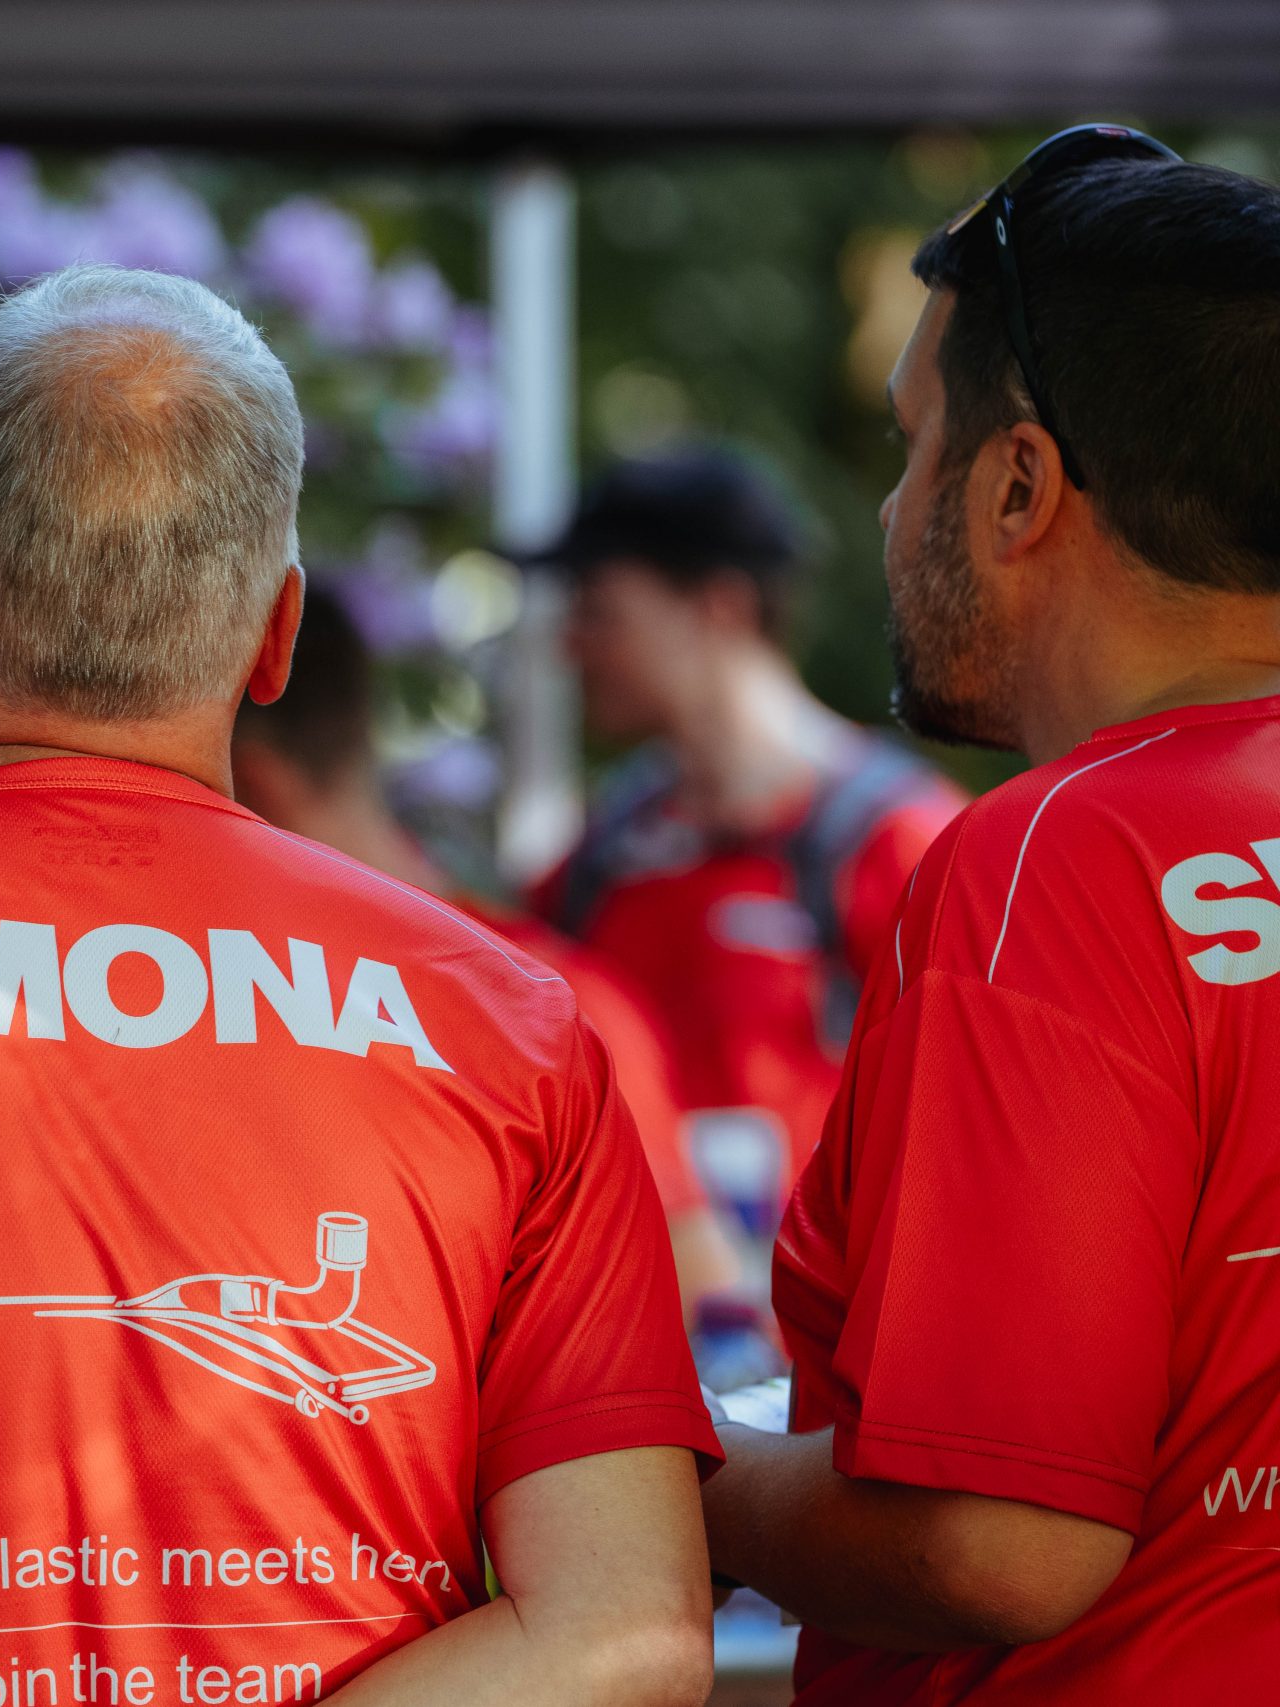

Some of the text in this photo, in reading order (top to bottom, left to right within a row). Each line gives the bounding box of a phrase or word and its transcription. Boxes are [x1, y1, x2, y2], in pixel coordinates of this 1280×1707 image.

[161, 1536, 335, 1587] meets
[69, 1652, 155, 1706] the
[175, 1654, 323, 1705] team
